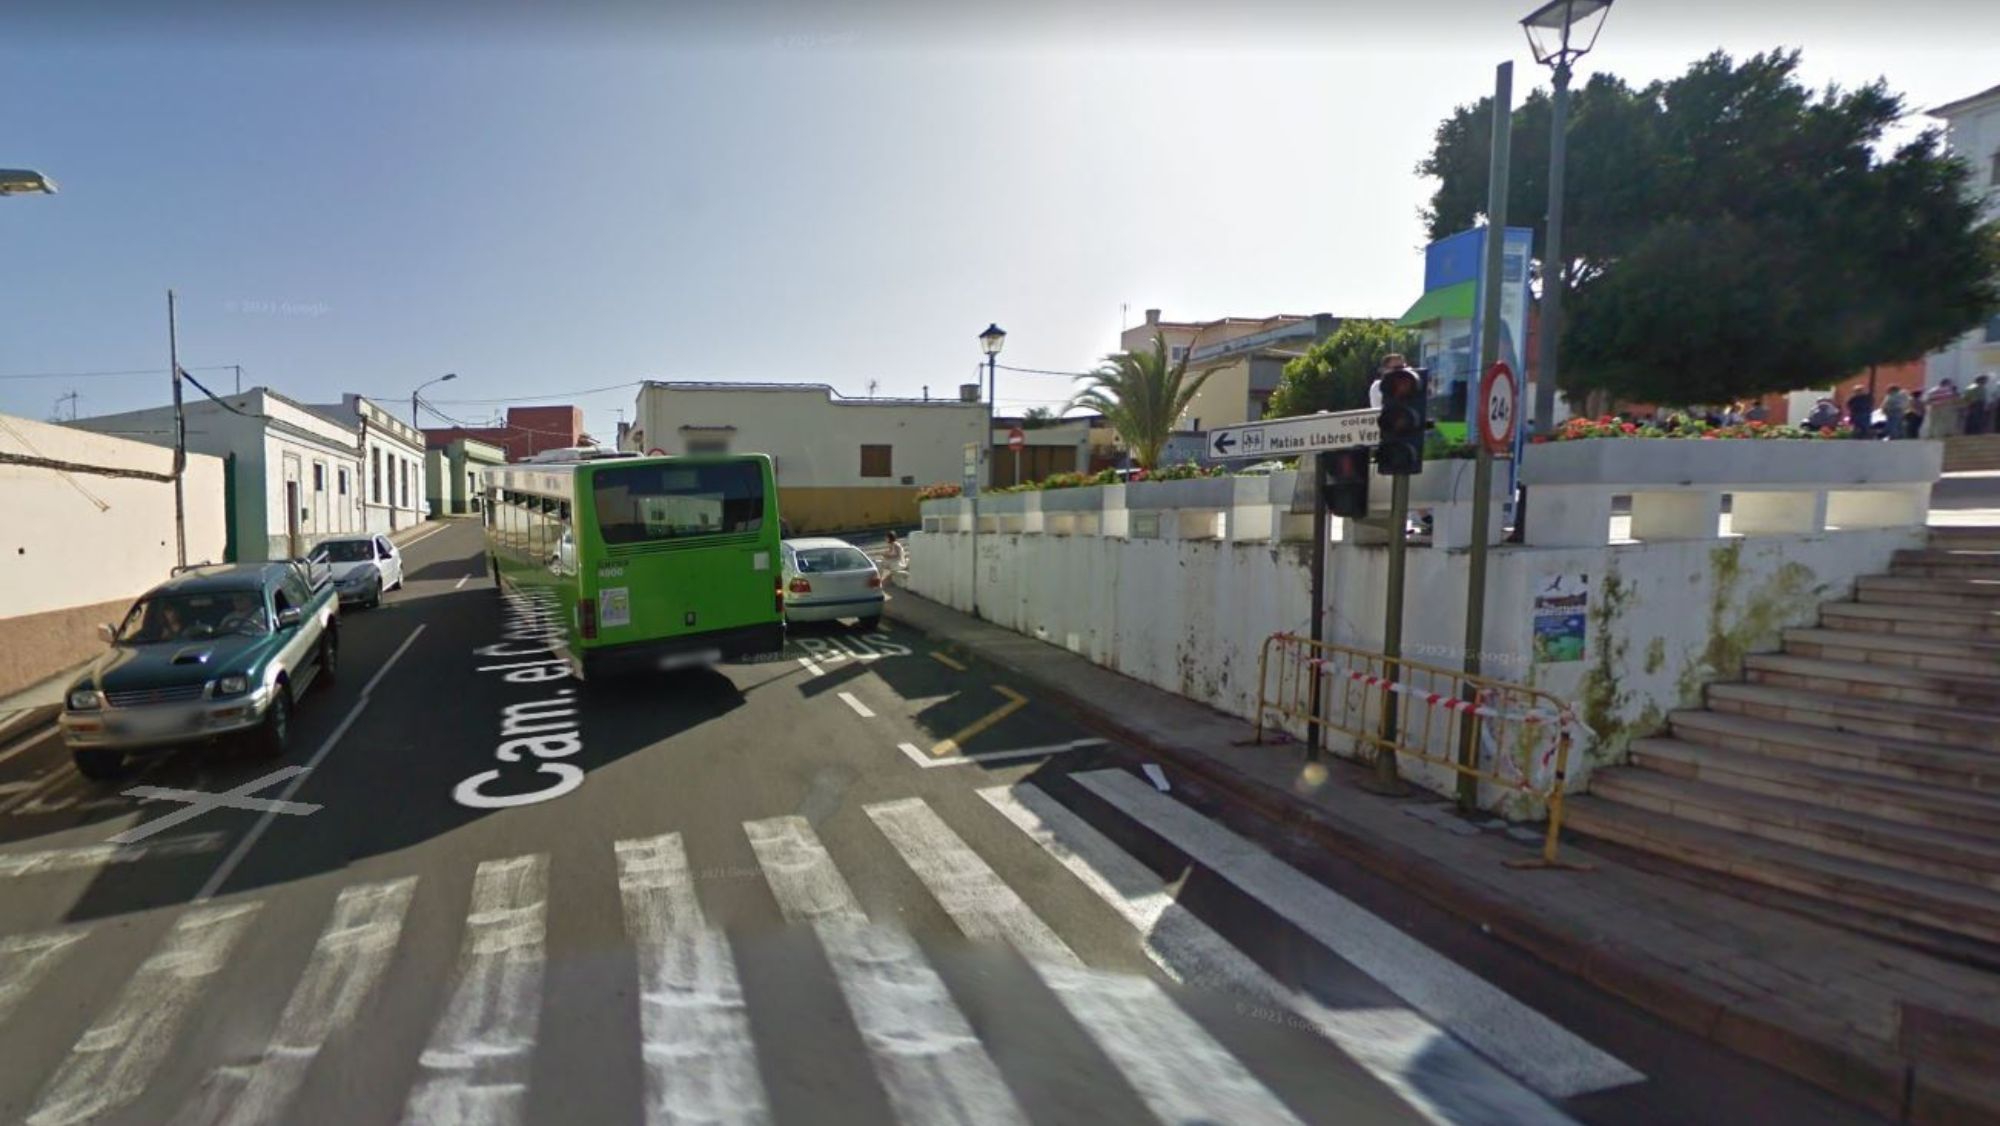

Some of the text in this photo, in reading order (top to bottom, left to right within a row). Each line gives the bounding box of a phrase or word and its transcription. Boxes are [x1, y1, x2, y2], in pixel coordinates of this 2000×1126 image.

[1270, 436, 1305, 449] Matias
[1310, 432, 1353, 446] Llabres
[797, 633, 913, 663] BUS
